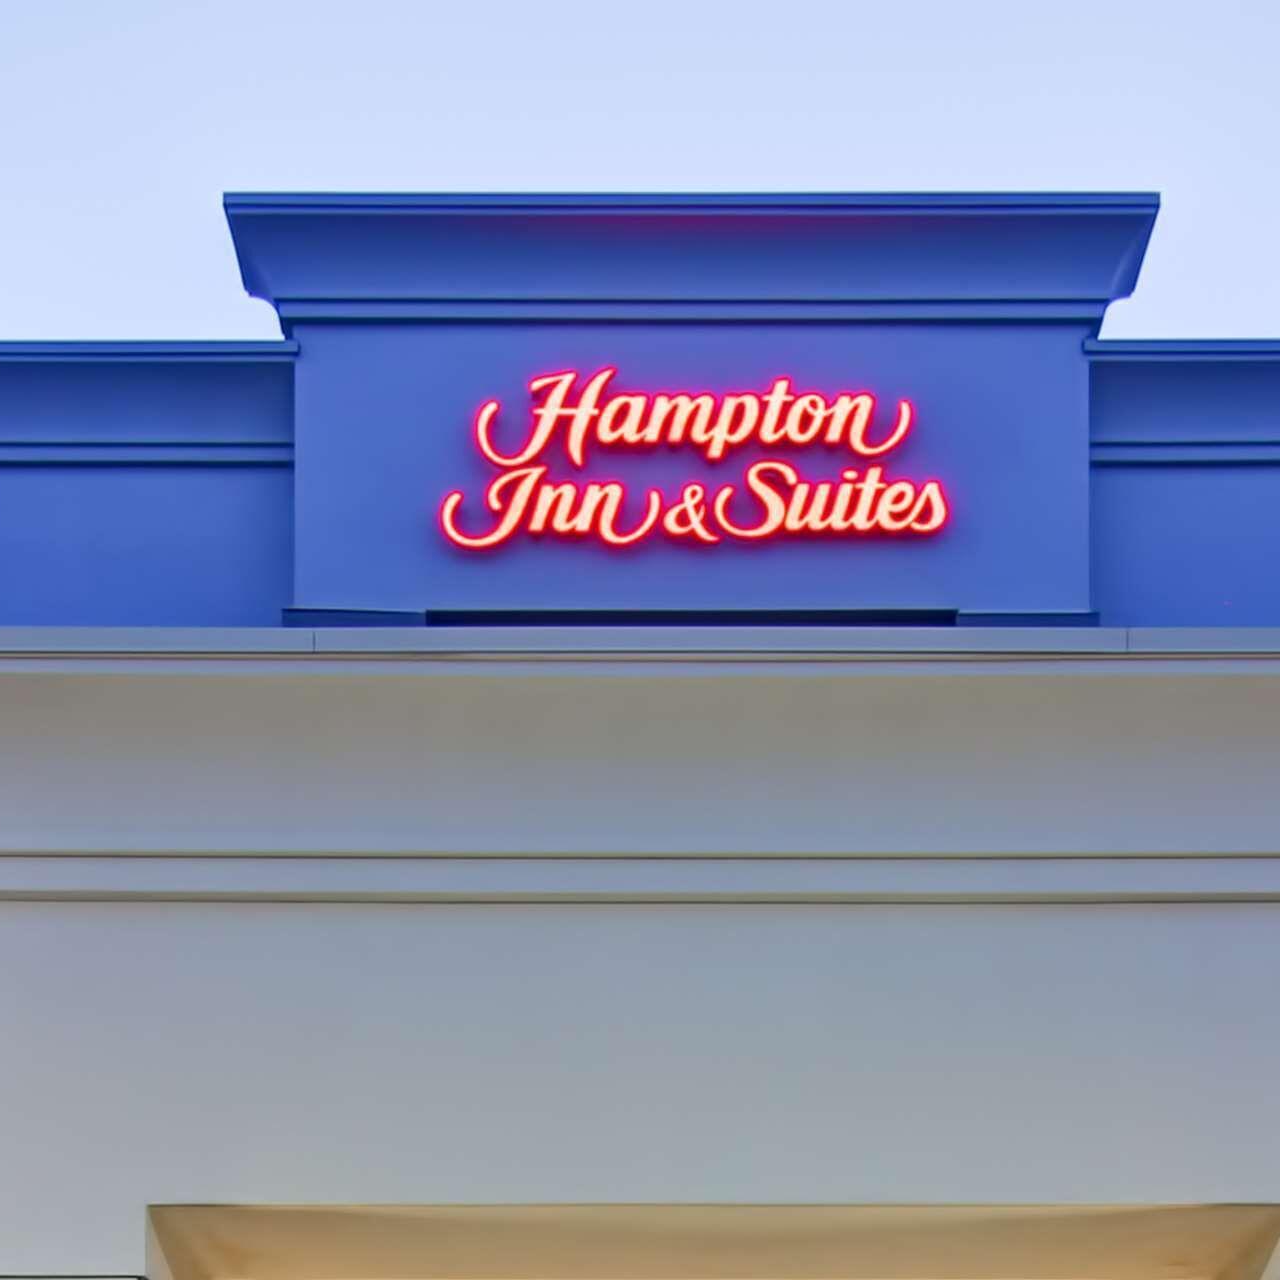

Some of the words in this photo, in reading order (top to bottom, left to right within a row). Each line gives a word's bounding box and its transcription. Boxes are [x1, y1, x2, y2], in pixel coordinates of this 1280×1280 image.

[476, 368, 911, 466] Hampton
[441, 466, 660, 547] Inn
[663, 483, 719, 542] &
[715, 461, 947, 537] Suites
